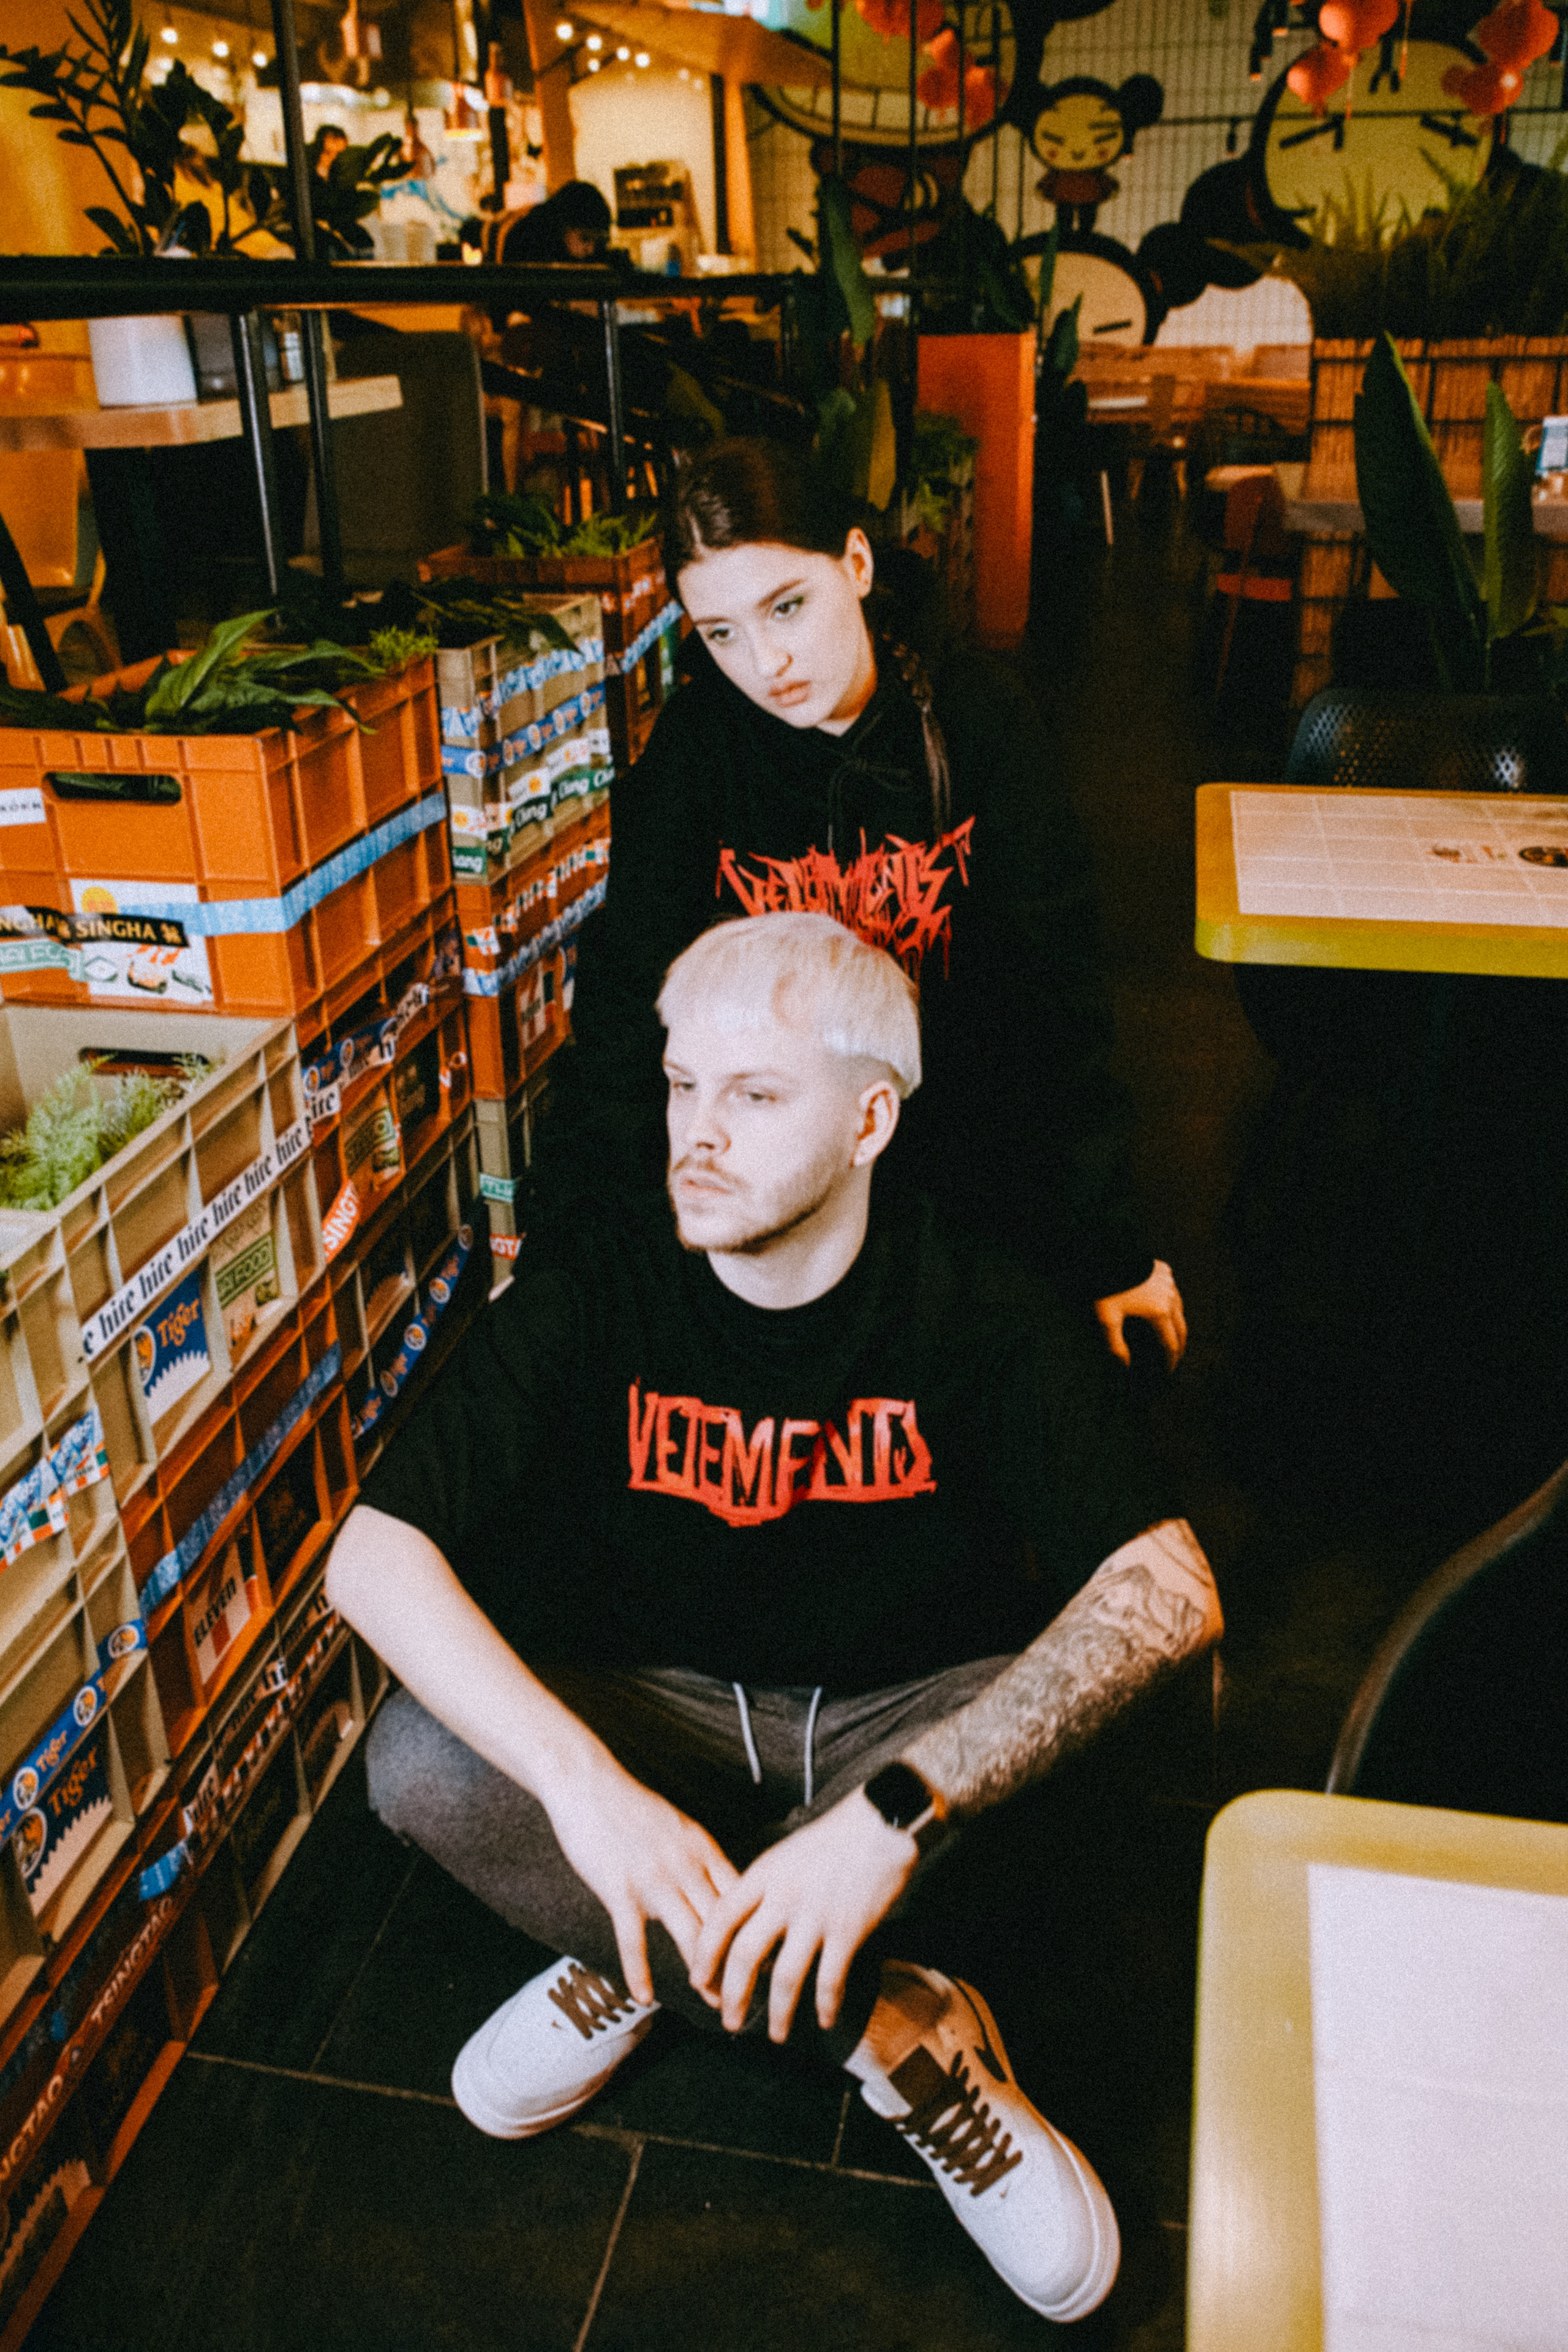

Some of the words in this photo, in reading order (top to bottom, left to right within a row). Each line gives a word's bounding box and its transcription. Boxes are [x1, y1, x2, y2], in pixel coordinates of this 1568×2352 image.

[75, 919, 157, 941] SINGHA
[156, 1297, 200, 1348] Tiger
[628, 1376, 937, 1528] VETEMENTS
[47, 1746, 98, 1817] Tiger
